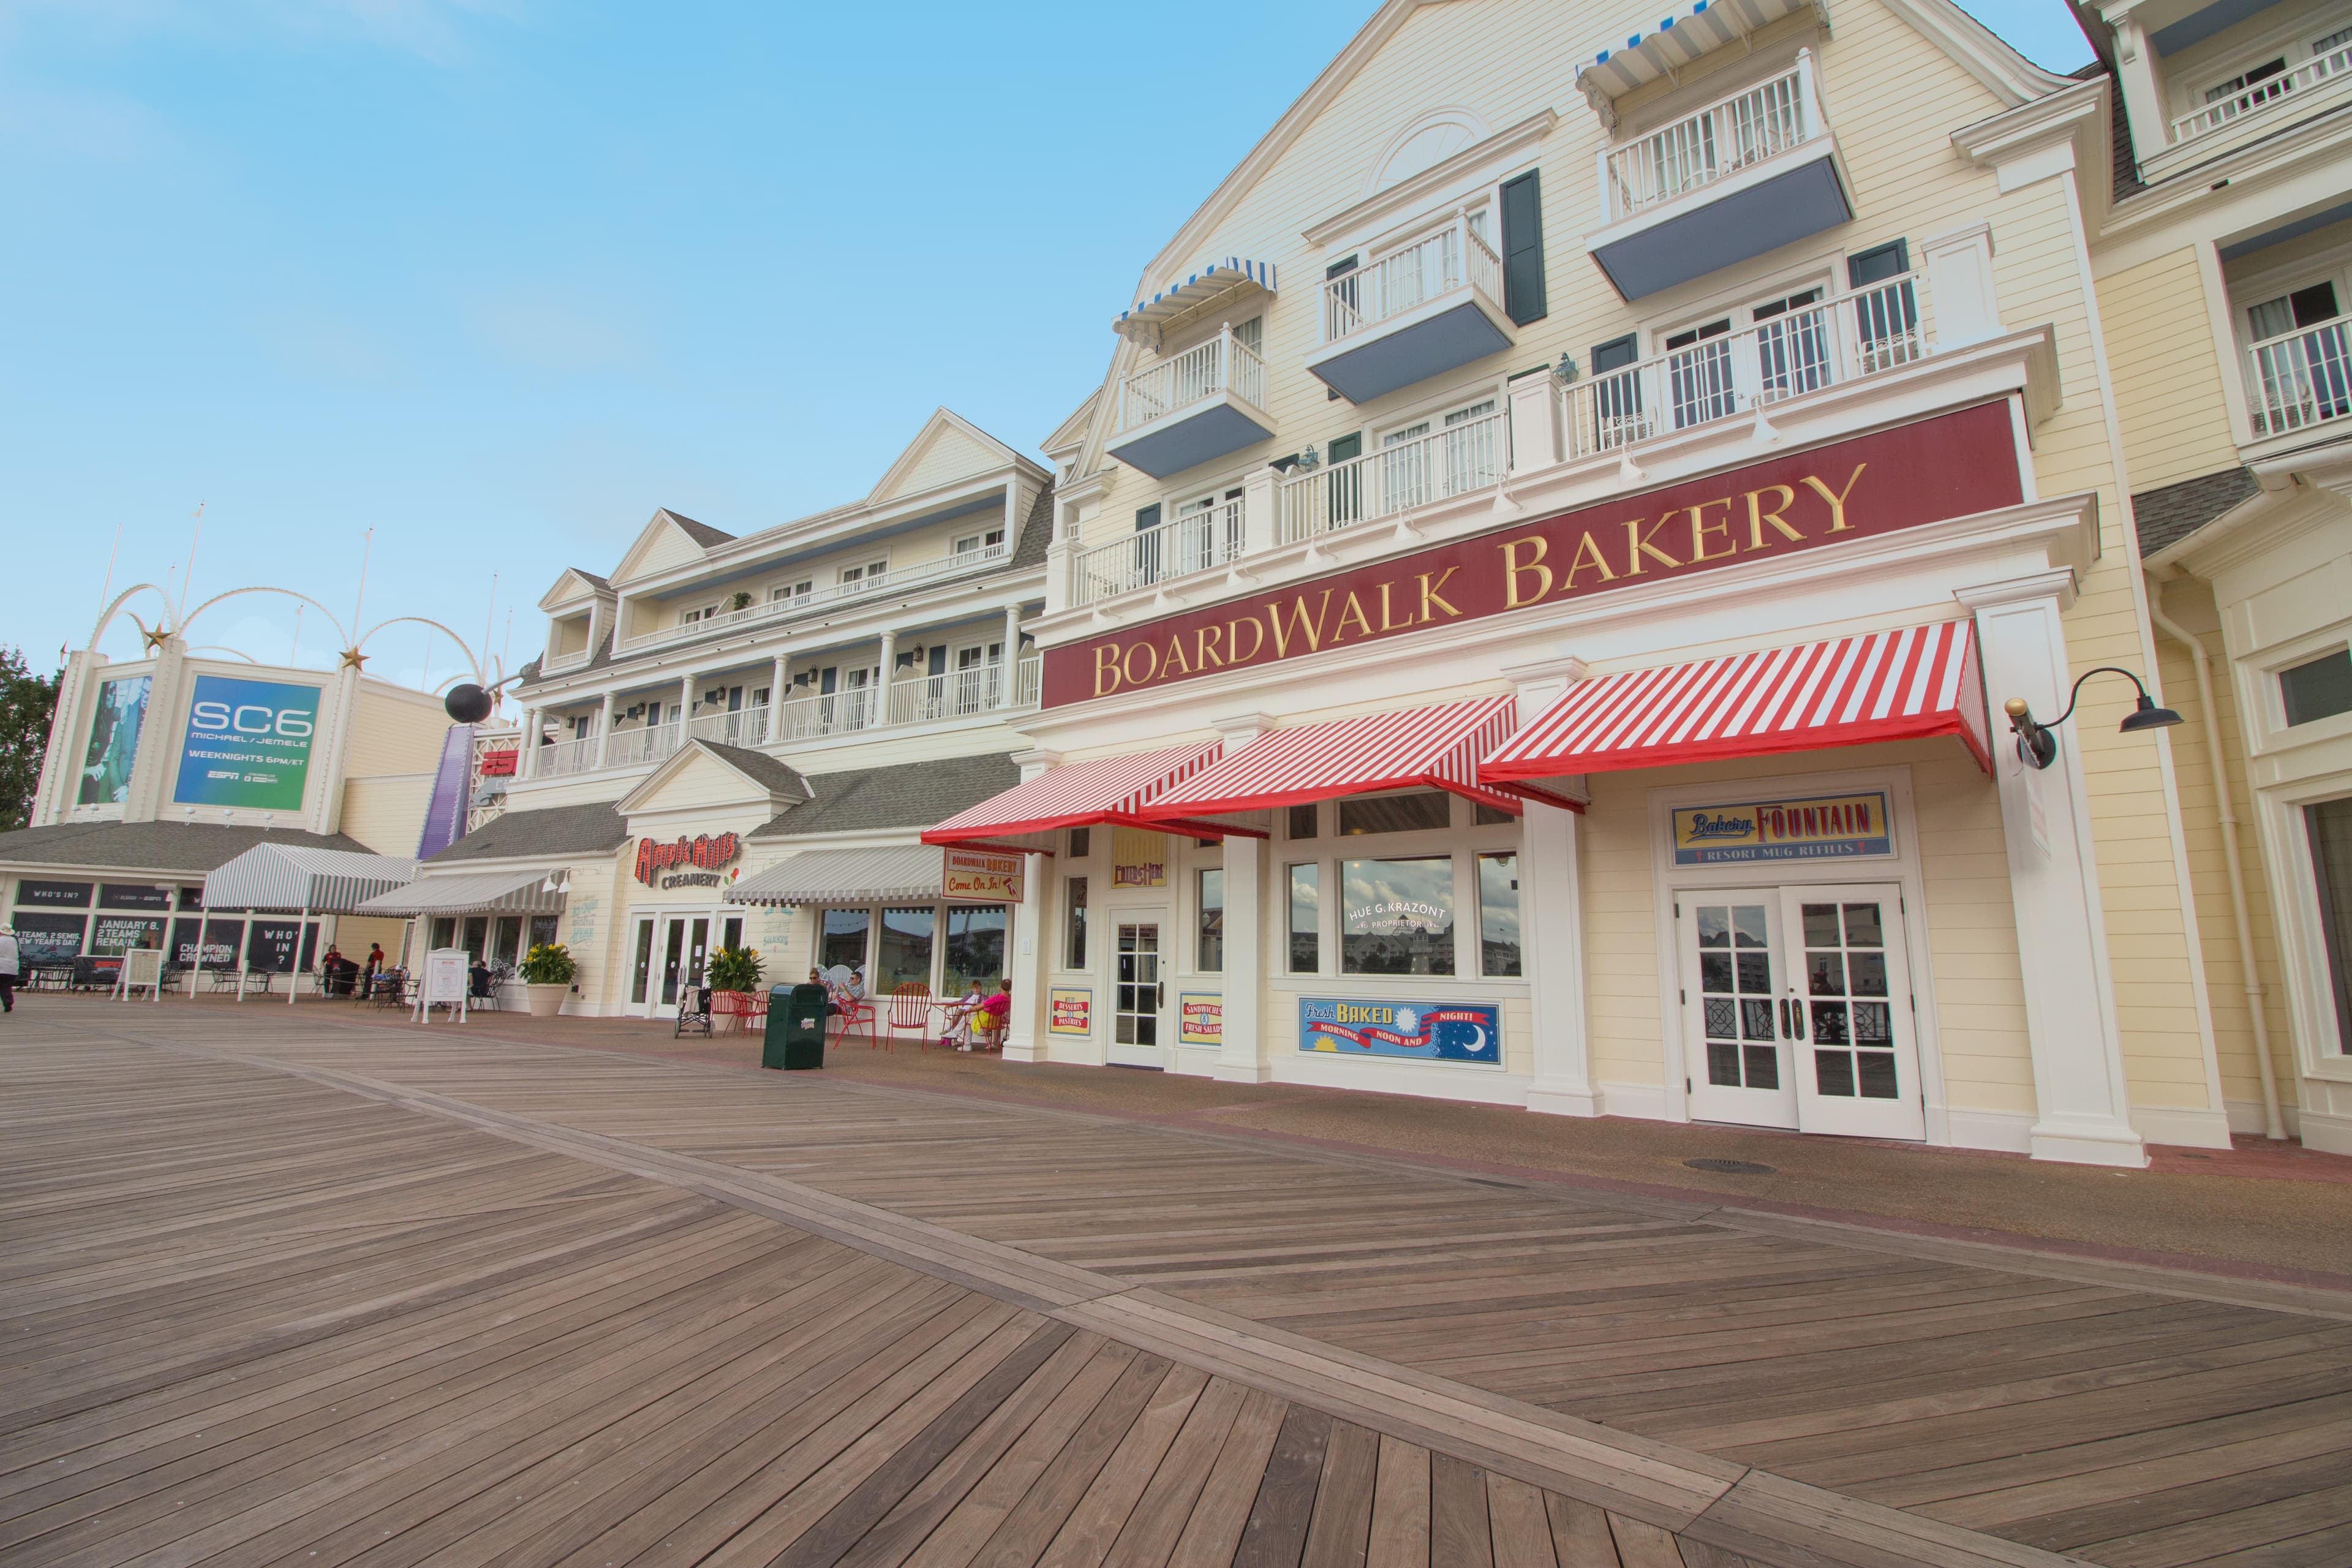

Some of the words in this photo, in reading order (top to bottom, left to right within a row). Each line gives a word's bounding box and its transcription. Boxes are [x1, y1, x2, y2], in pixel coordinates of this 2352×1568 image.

[1091, 566, 1464, 698] BOARDWALK
[1497, 463, 1868, 610] BAKERY
[192, 702, 314, 737] SC6
[191, 733, 247, 744] MICHAEL
[256, 738, 308, 748] JEMELE
[189, 750, 263, 763] WEEKNIGHTS
[265, 756, 304, 766] 6PM/ET
[207, 771, 240, 780] ESPN
[1686, 813, 1755, 843] Bakery
[1755, 803, 1871, 843] FOUNTAIN
[635, 835, 692, 888] Ample
[692, 831, 739, 870] Hills
[1708, 849, 1756, 861] RESORT
[1763, 847, 1793, 858] MUG
[1800, 842, 1853, 856] REFILLS
[952, 856, 986, 868] BOARDWALK
[986, 858, 1017, 874] BAKERY
[661, 873, 721, 891] CREAMERY
[949, 877, 971, 892] Come
[973, 876, 986, 891] On
[987, 876, 1001, 890] In!
[1349, 906, 1372, 922] HUE
[1375, 904, 1386, 913] G.
[1389, 902, 1446, 919] KRAZONT
[99, 920, 148, 930] JANUARY
[1372, 920, 1422, 929] PROPRIETOR
[106, 929, 140, 938] TEAMS
[276, 943, 290, 952] IN
[1186, 1005, 1222, 1015] SANDWICHES
[1305, 1003, 1335, 1019] Fresh
[1336, 1003, 1393, 1024] BAKED
[1185, 1023, 1202, 1032] FRESH
[1320, 1024, 1359, 1041] MORNING
[1376, 1031, 1401, 1044] NOON
[1404, 1038, 1423, 1047] AND
